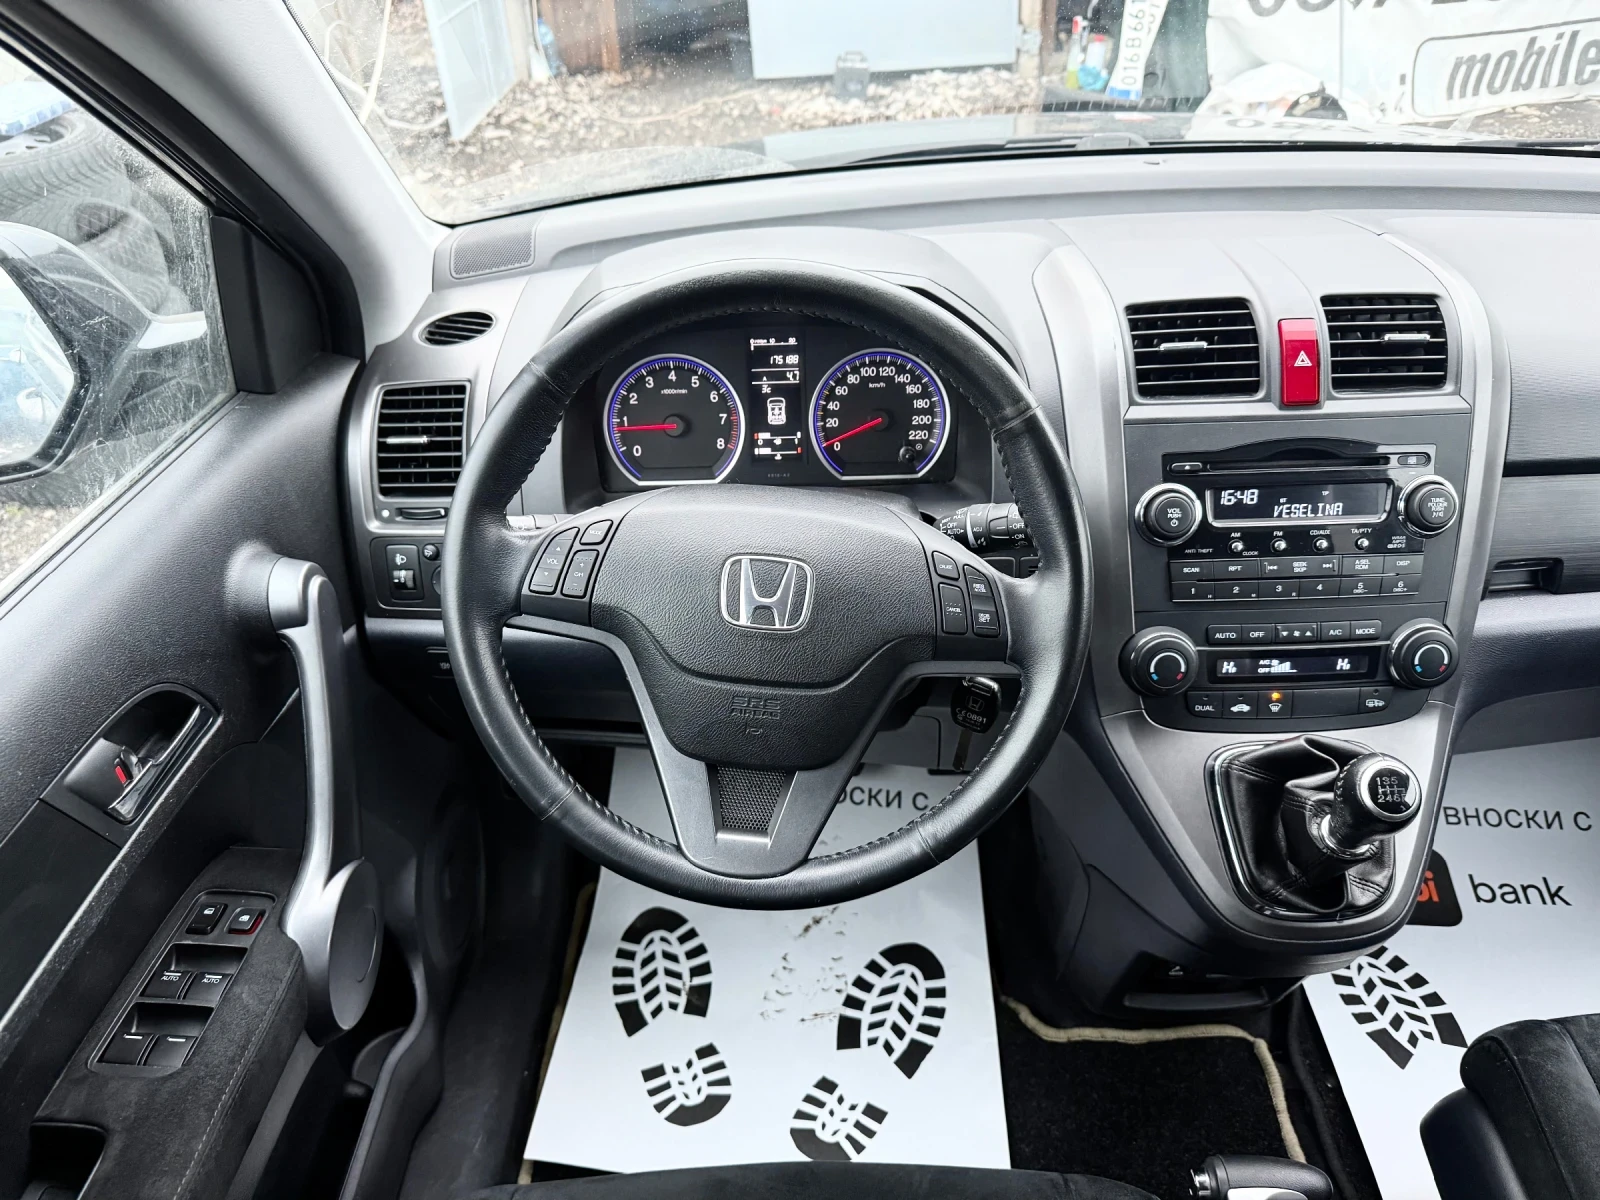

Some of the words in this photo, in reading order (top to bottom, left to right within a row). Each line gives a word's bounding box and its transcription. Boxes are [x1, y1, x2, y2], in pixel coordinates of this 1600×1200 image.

[1447, 30, 1600, 100] mobile
[668, 370, 677, 382] 4
[860, 366, 876, 377] 100
[879, 366, 896, 376] 120
[645, 376, 654, 388] 3
[691, 376, 700, 388] 5
[847, 374, 860, 384] 80
[894, 373, 911, 383] 140
[835, 386, 848, 396] 60
[905, 384, 922, 394] 160
[629, 393, 638, 404] 2
[709, 391, 719, 402] 6
[827, 400, 840, 411] 40
[913, 398, 930, 409] 180
[622, 416, 628, 427] 1
[719, 413, 727, 425] 7
[825, 418, 839, 428] 20
[911, 415, 932, 425] 200
[908, 430, 929, 440] 220
[716, 438, 725, 450] 8
[833, 441, 841, 451] 0
[633, 445, 642, 456] 0
[1220, 489, 1259, 505] 16:48
[1273, 503, 1344, 518] VESELINA
[1232, 586, 1240, 594] 2
[1355, 627, 1376, 635] MODE
[966, 711, 987, 724] 0891
[1375, 776, 1381, 786] 1
[1391, 776, 1398, 785] 5
[1377, 794, 1385, 803] 2
[1385, 794, 1392, 802] 4
[1393, 794, 1400, 802] 6
[1443, 806, 1564, 830] ВНОСКИ
[1573, 811, 1592, 832] С
[1467, 873, 1573, 907] bank
